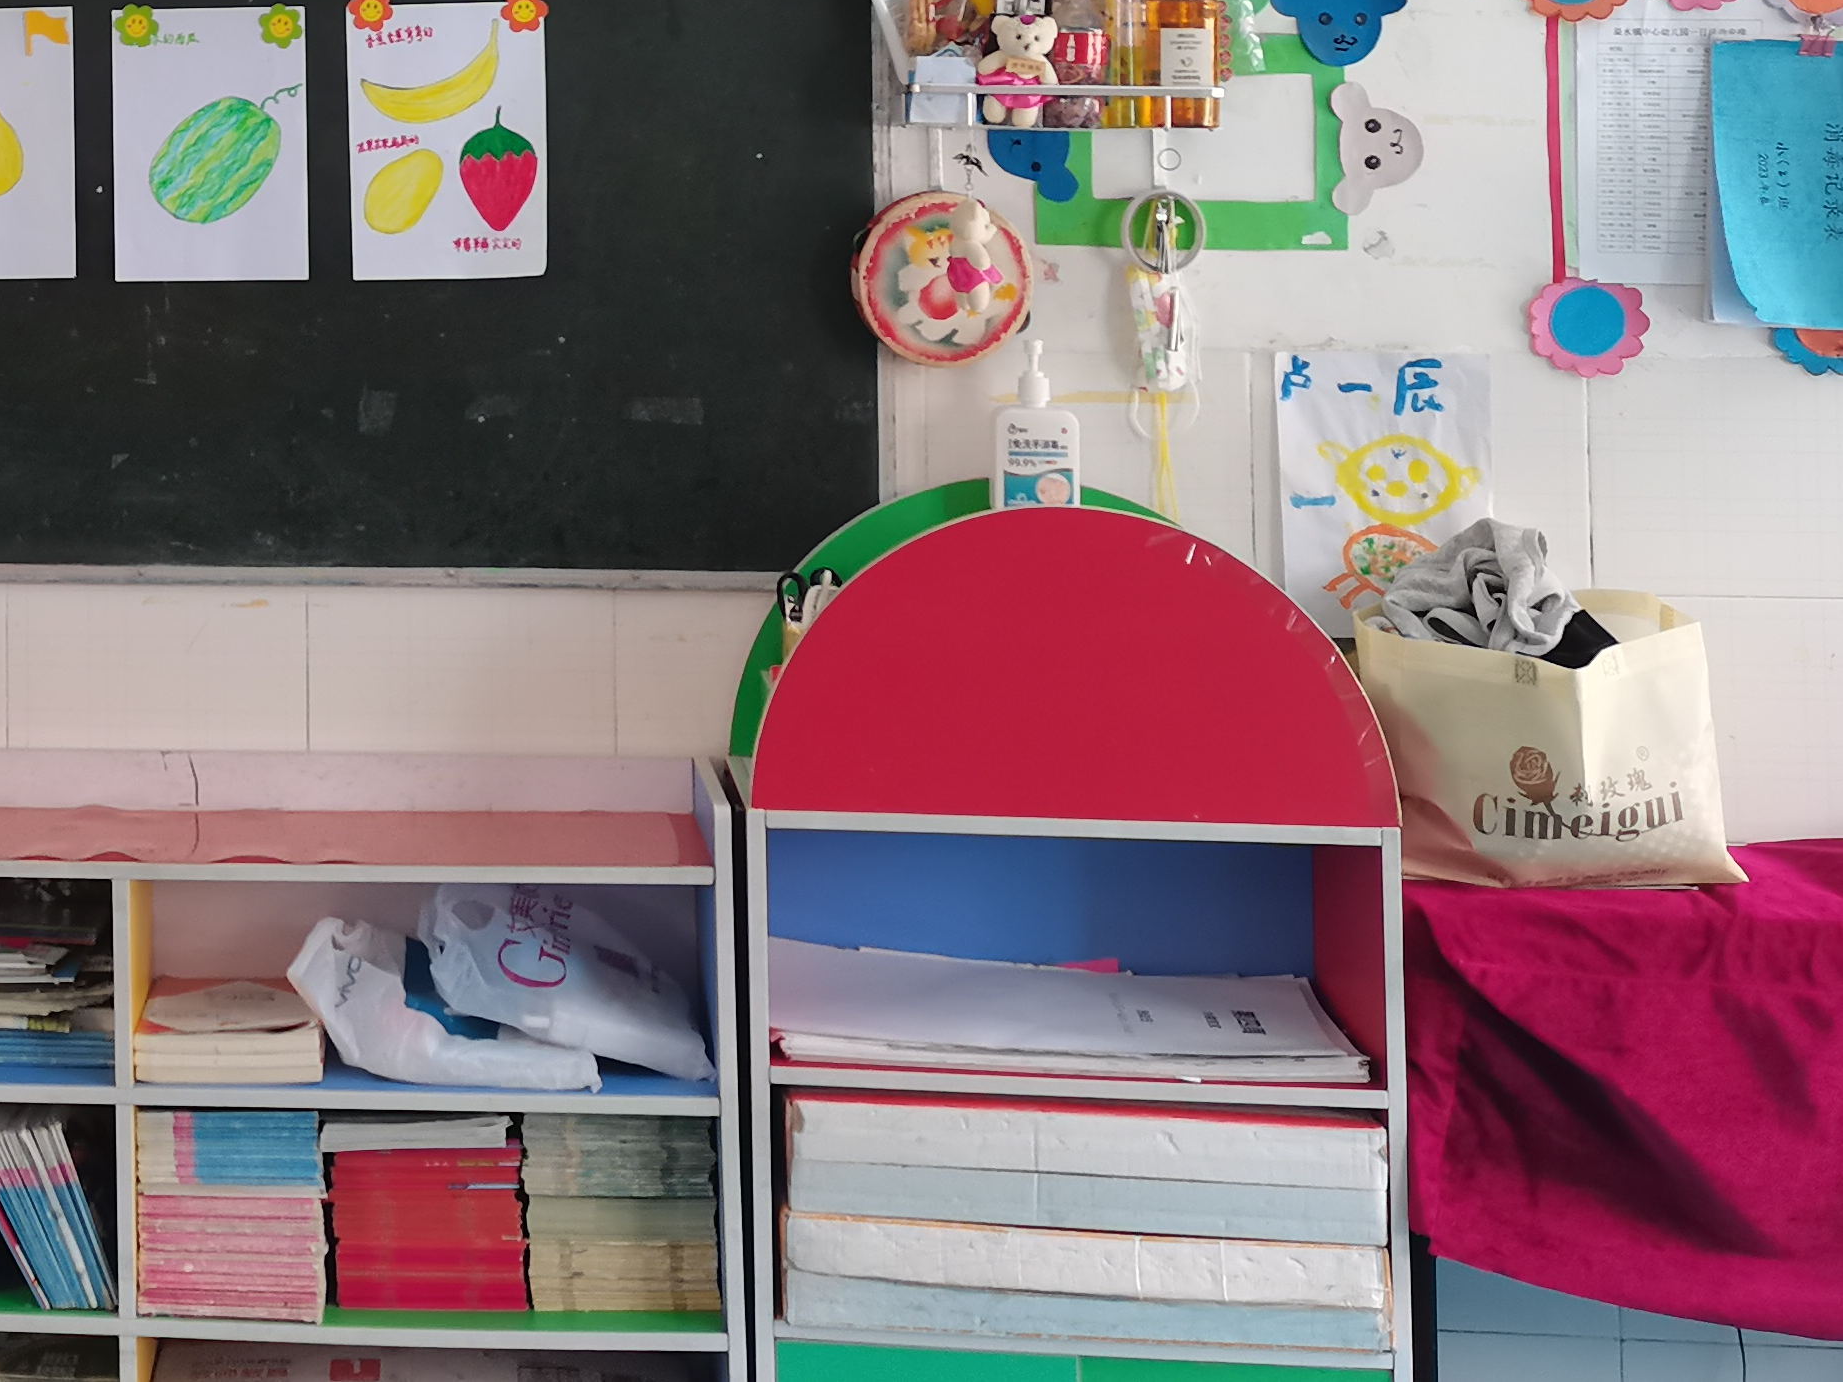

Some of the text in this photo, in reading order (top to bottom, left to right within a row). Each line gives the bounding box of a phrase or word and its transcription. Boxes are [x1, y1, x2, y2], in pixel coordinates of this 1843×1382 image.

[1472, 781, 1685, 843] Cimeigui
[1569, 767, 1653, 807] 刺玫瑰
